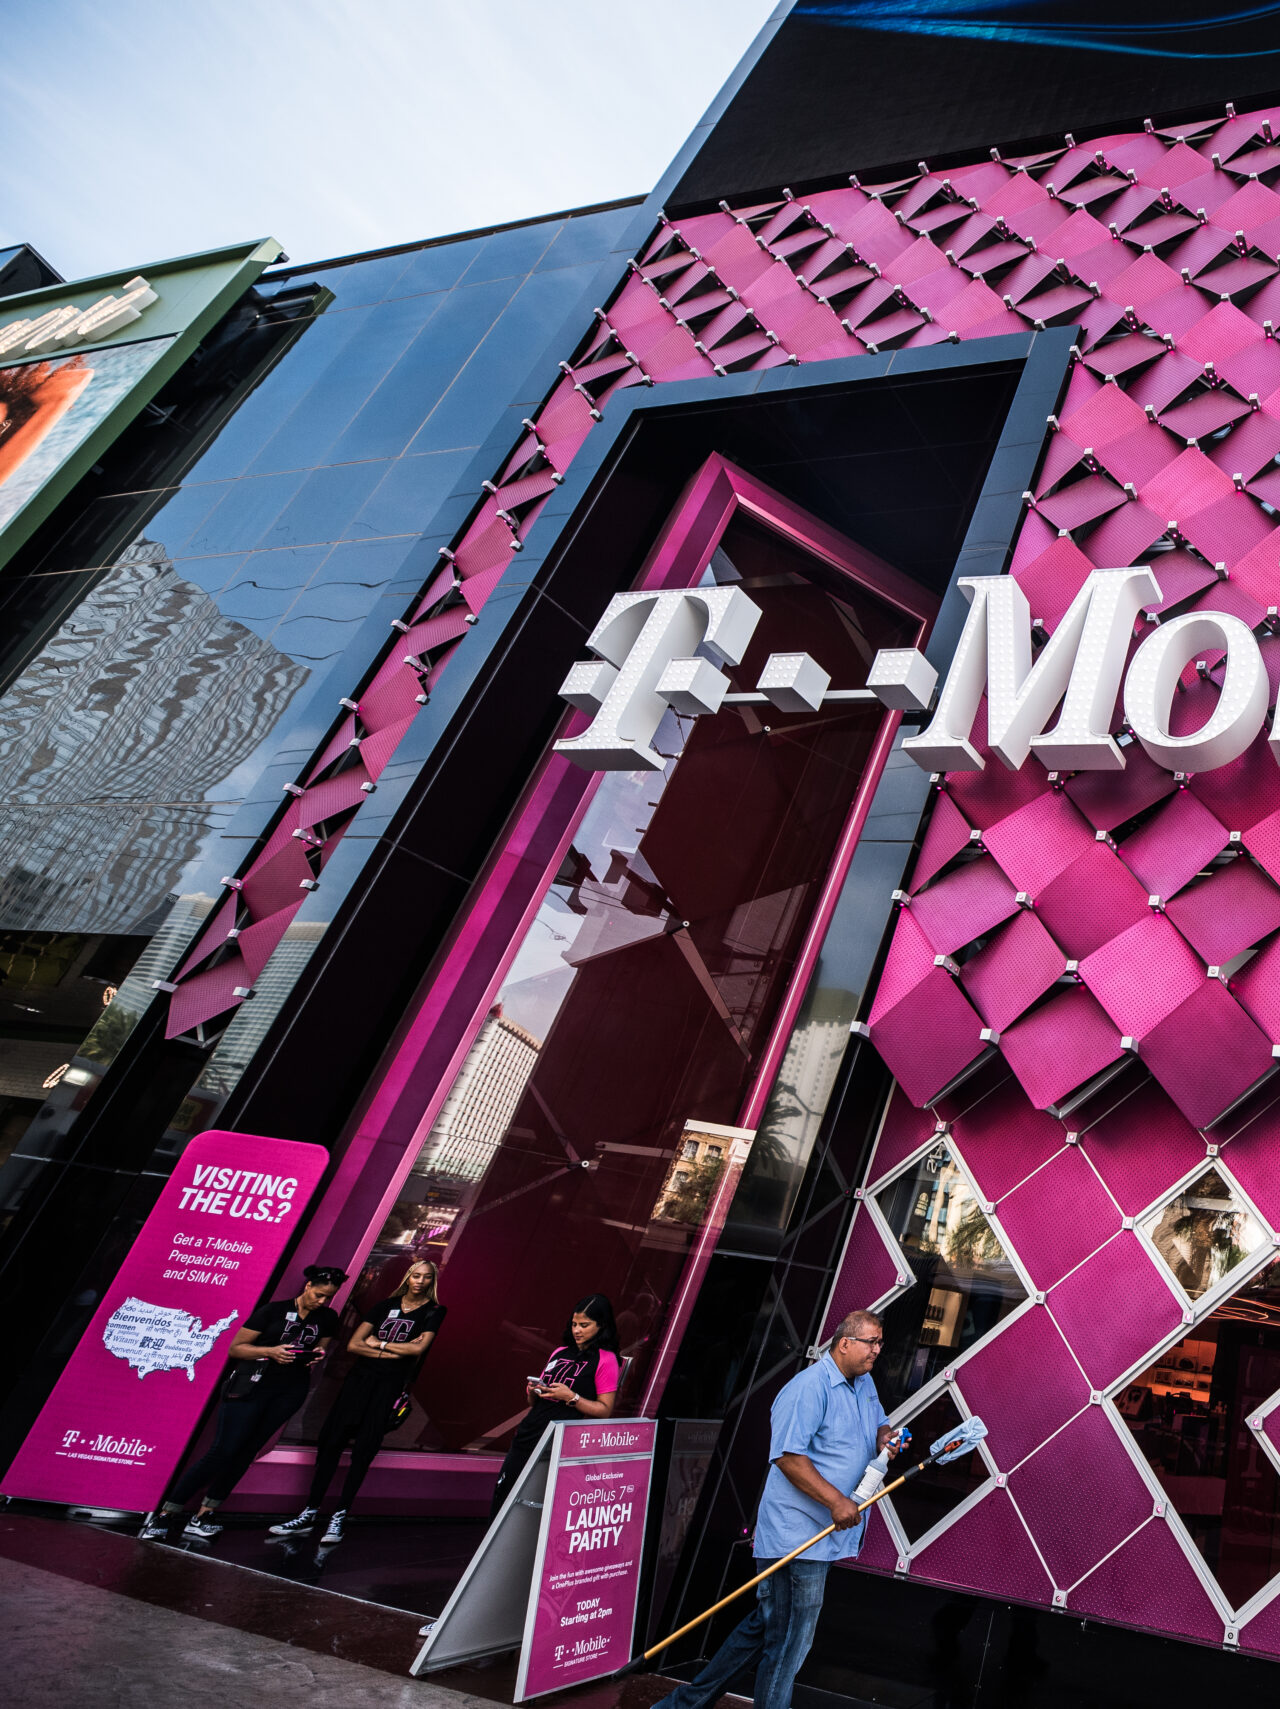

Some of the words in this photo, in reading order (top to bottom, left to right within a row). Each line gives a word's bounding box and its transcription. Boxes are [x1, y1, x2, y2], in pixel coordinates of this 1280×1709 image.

[192, 1164, 298, 1200] VISITING
[178, 1187, 231, 1215] THE
[229, 1195, 292, 1223] U.S.?
[173, 1232, 194, 1245] Get
[194, 1238, 202, 1247] a
[205, 1237, 253, 1254] T-Mobile
[168, 1249, 214, 1267] Prepaid
[213, 1256, 240, 1270] Plan
[163, 1269, 187, 1280] and
[187, 1269, 209, 1284] SIM
[210, 1273, 228, 1286] Kit
[113, 1311, 172, 1328] Bienvenidos
[112, 1335, 139, 1345] Witamy
[585, 1473, 601, 1482] Global
[602, 1472, 624, 1480] Exclusive
[569, 1488, 616, 1506] OnePlus
[619, 1485, 627, 1500] 7
[565, 1502, 632, 1531] LAUNCH
[568, 1525, 623, 1554] PARTY
[555, 1580, 574, 1589] OnePlus
[577, 1597, 600, 1612] TODAY
[560, 1612, 589, 1627] Starting
[589, 1610, 597, 1620] at
[597, 1608, 613, 1619] 2pm
